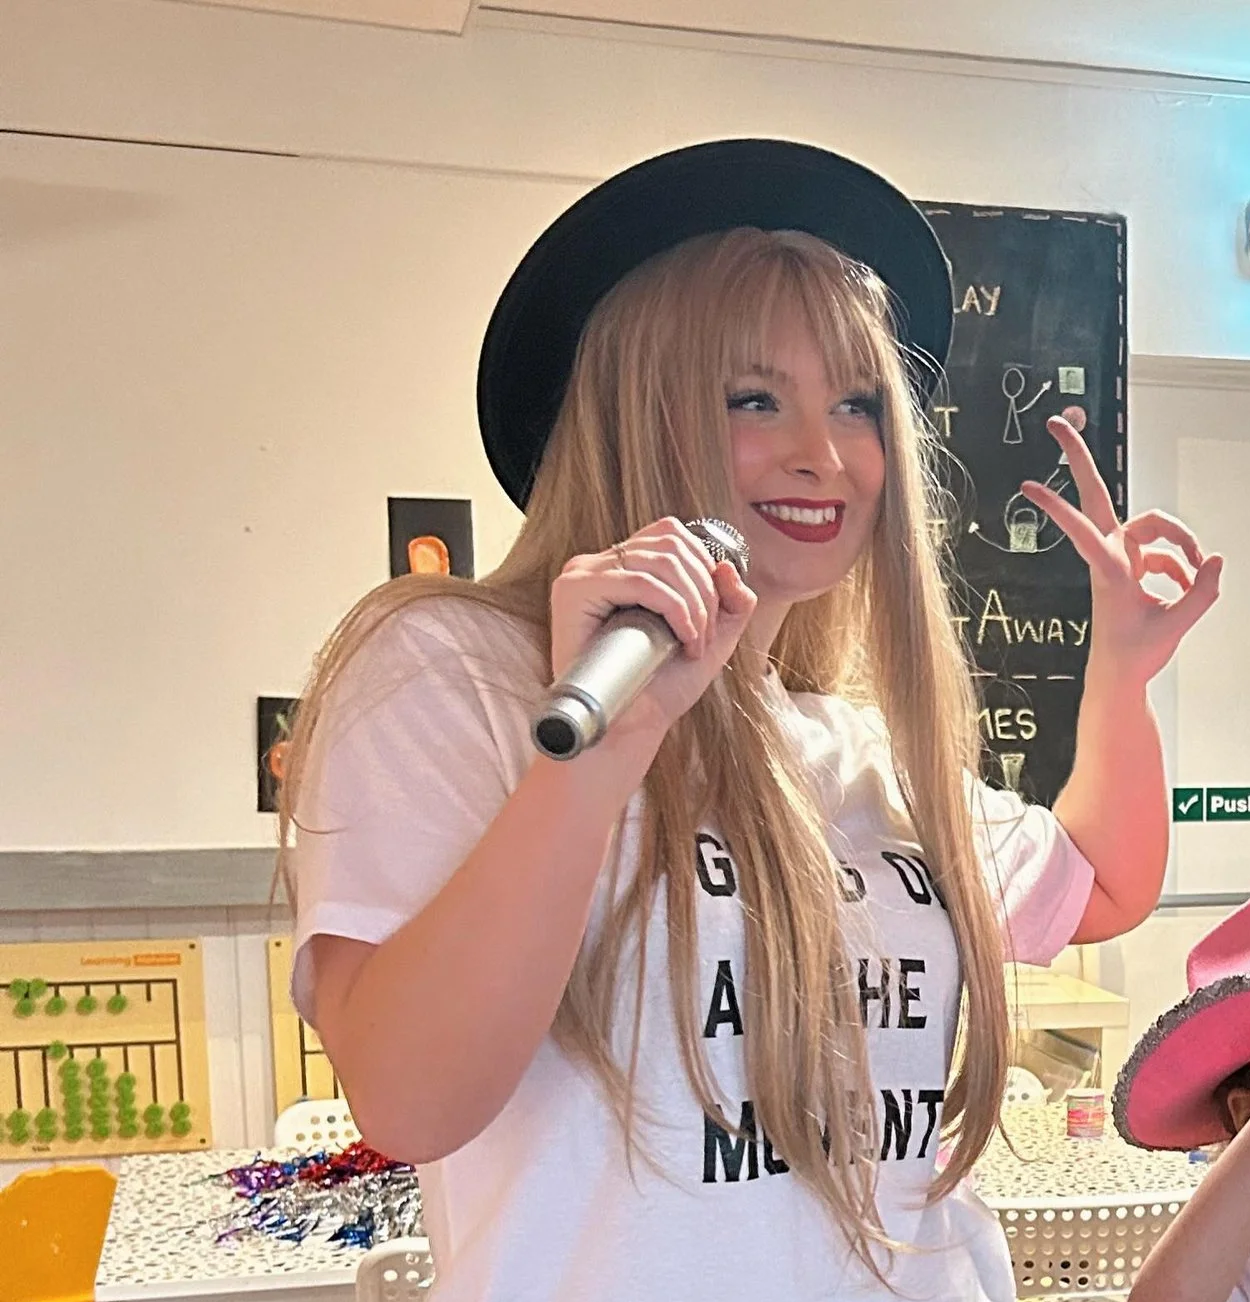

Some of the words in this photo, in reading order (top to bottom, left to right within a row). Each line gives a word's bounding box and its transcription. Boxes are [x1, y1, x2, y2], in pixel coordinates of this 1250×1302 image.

[954, 285, 1001, 316] AY
[858, 959, 927, 1028] HE
[702, 1089, 944, 1183] MNT
